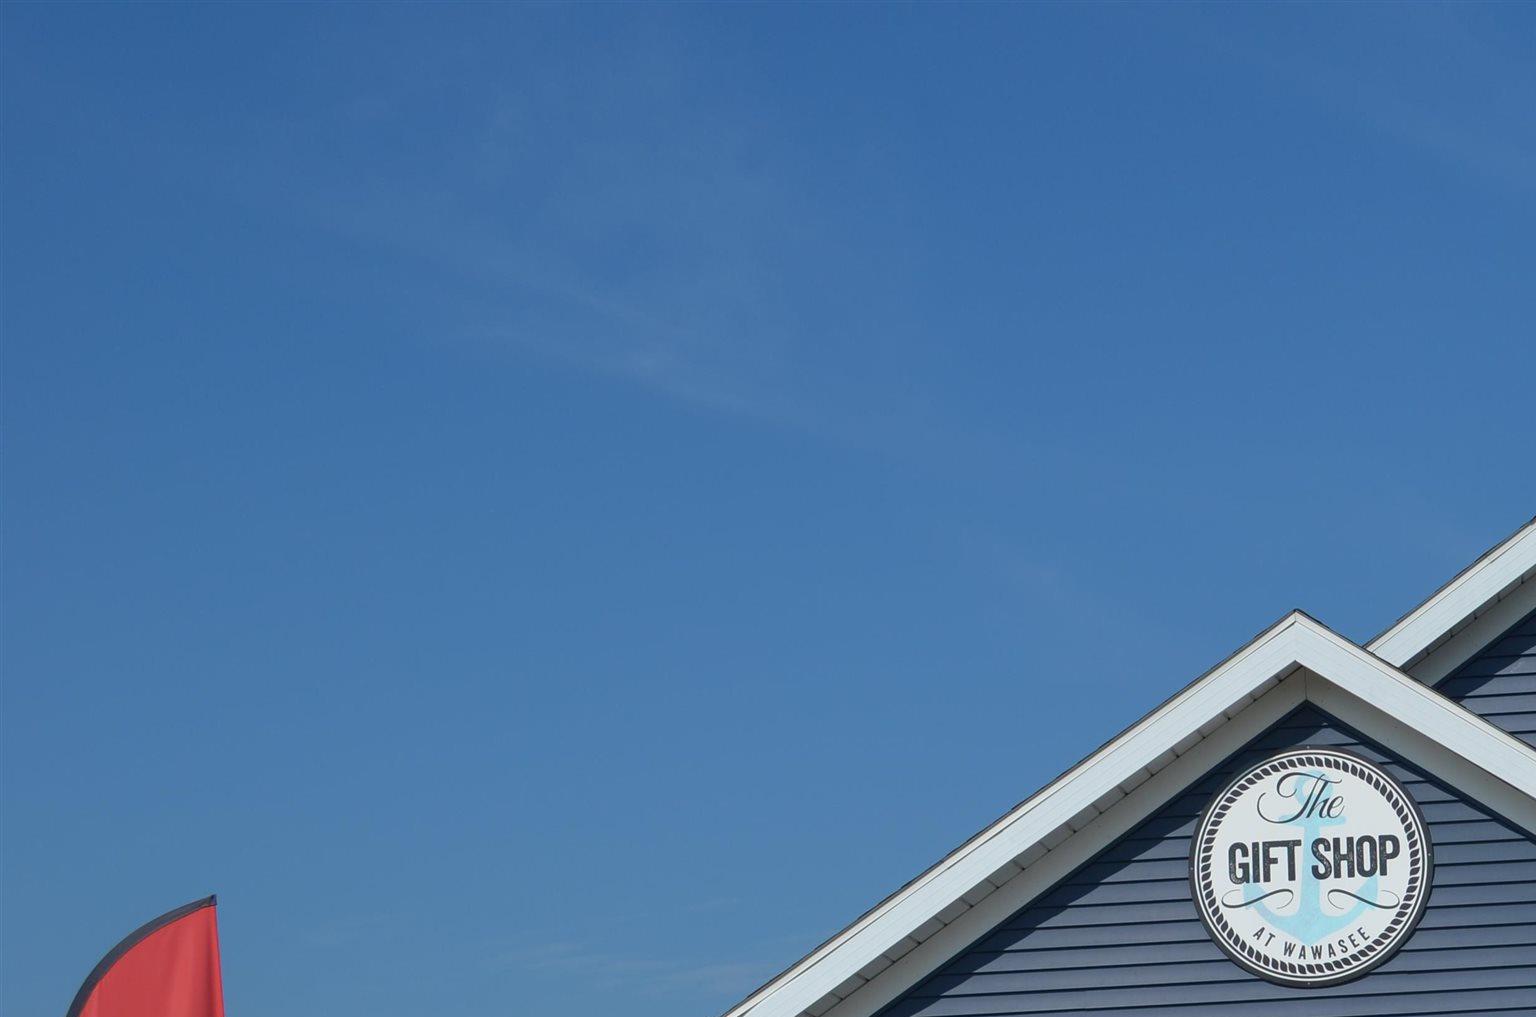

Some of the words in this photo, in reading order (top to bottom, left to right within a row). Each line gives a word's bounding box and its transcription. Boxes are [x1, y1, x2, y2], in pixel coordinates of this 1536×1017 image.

[1257, 771, 1345, 824] The
[1228, 839, 1302, 885] GIFT
[1311, 834, 1401, 880] SHOP
[1253, 926, 1276, 948] AT
[1284, 926, 1370, 961] WAWASEE
